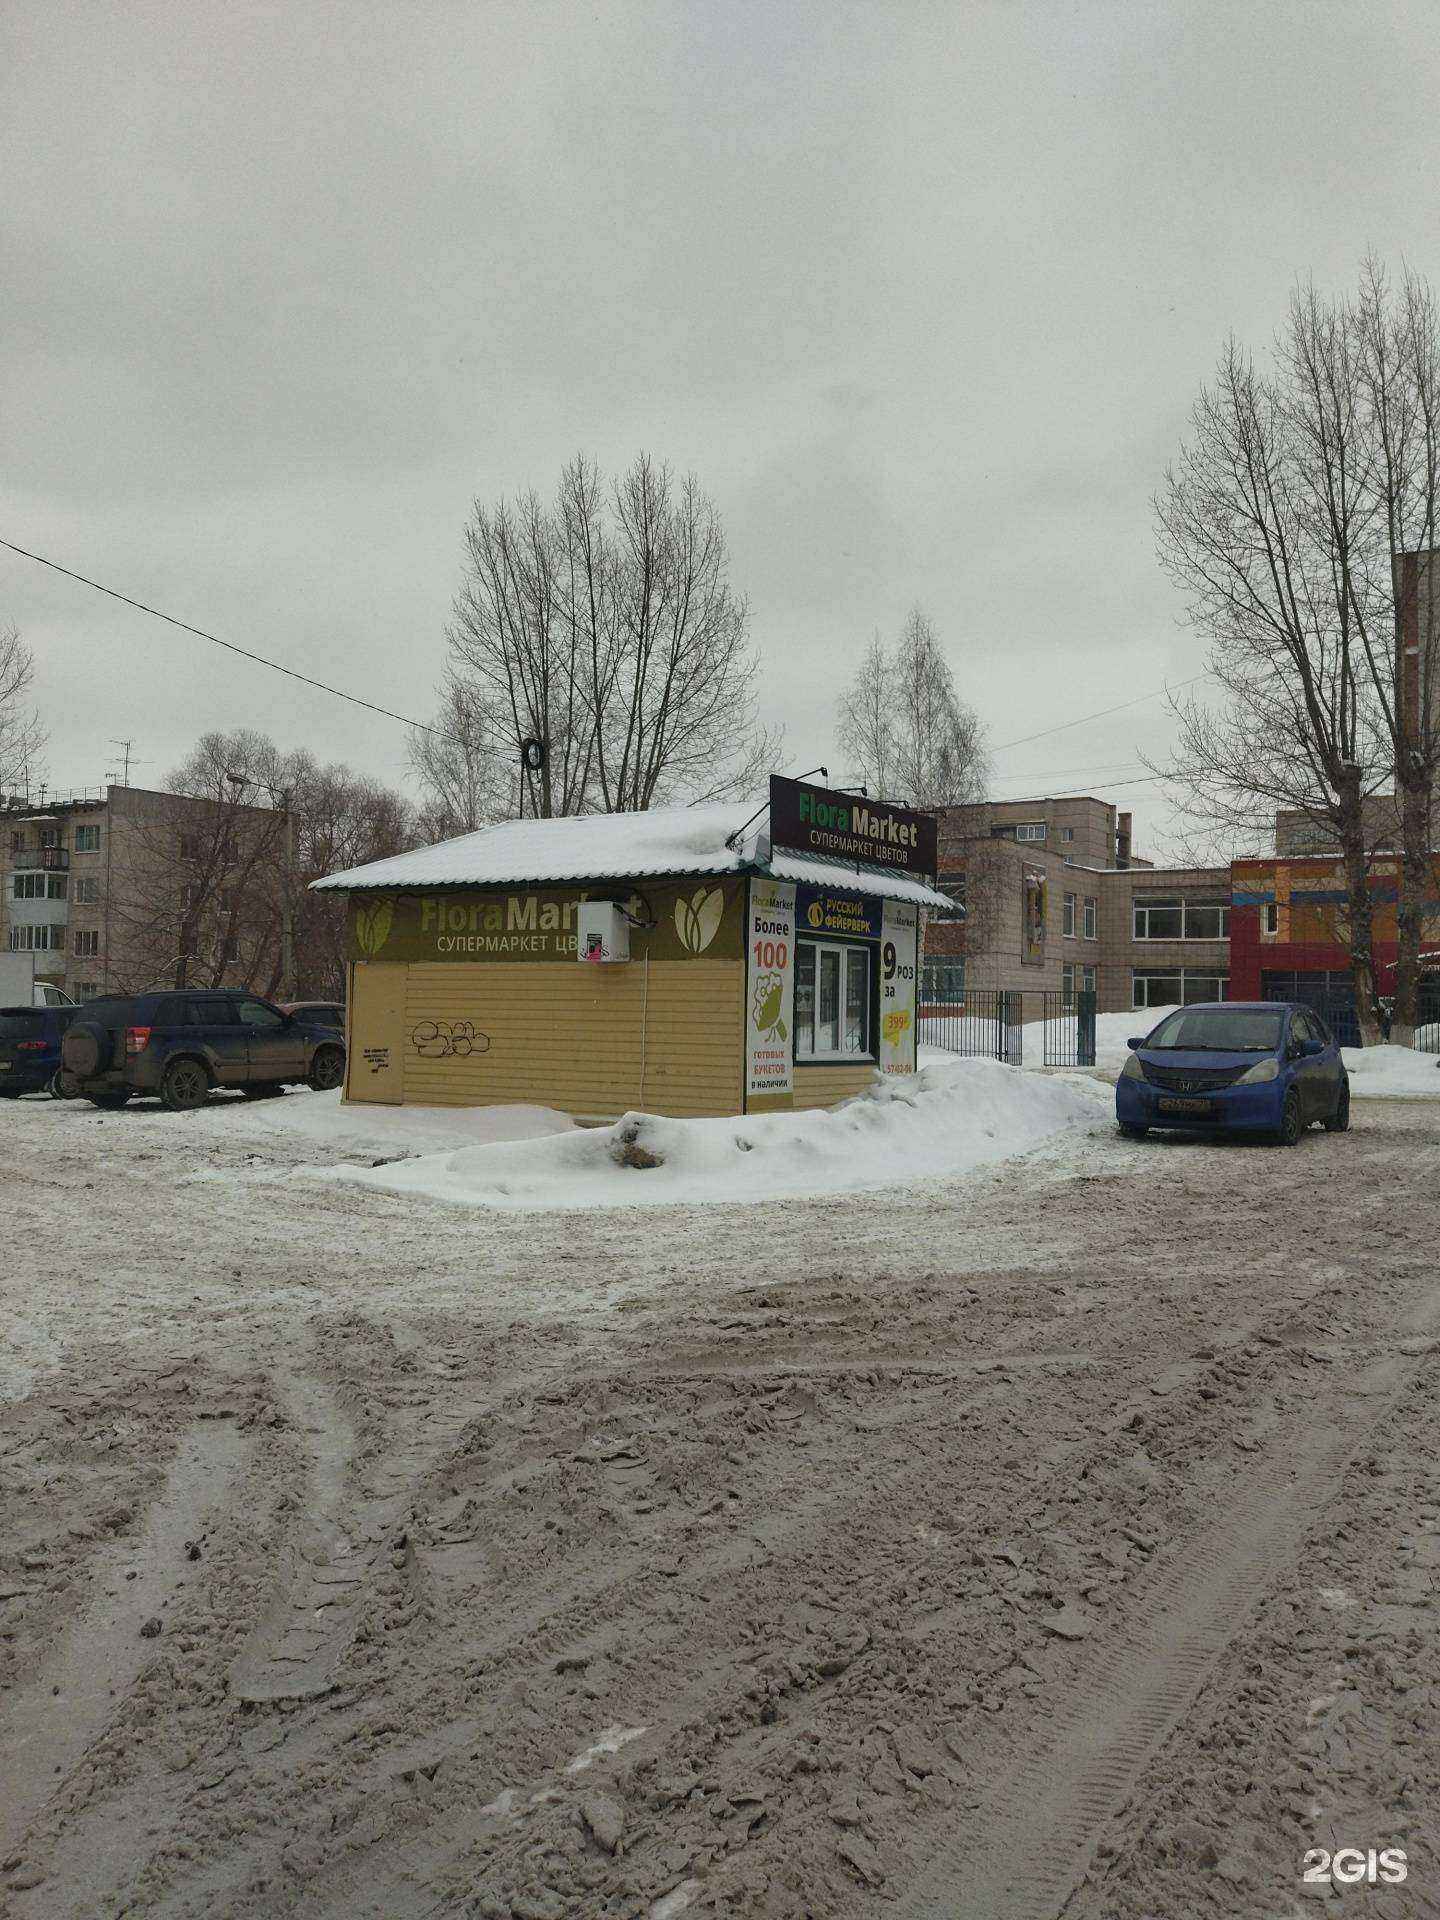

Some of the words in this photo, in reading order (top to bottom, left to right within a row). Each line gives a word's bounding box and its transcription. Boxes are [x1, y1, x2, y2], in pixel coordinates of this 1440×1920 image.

[810, 829, 873, 856] СУПЕРМАРКЕТ
[875, 844, 908, 864] ЦВЕТОВ
[826, 898, 864, 917] РУССКИЙ
[754, 917, 789, 936] Более
[437, 935, 548, 951] СУПЕРМАРКЕТ
[754, 941, 787, 969] 100
[883, 942, 897, 980] 9
[897, 965, 914, 980] РОЗ
